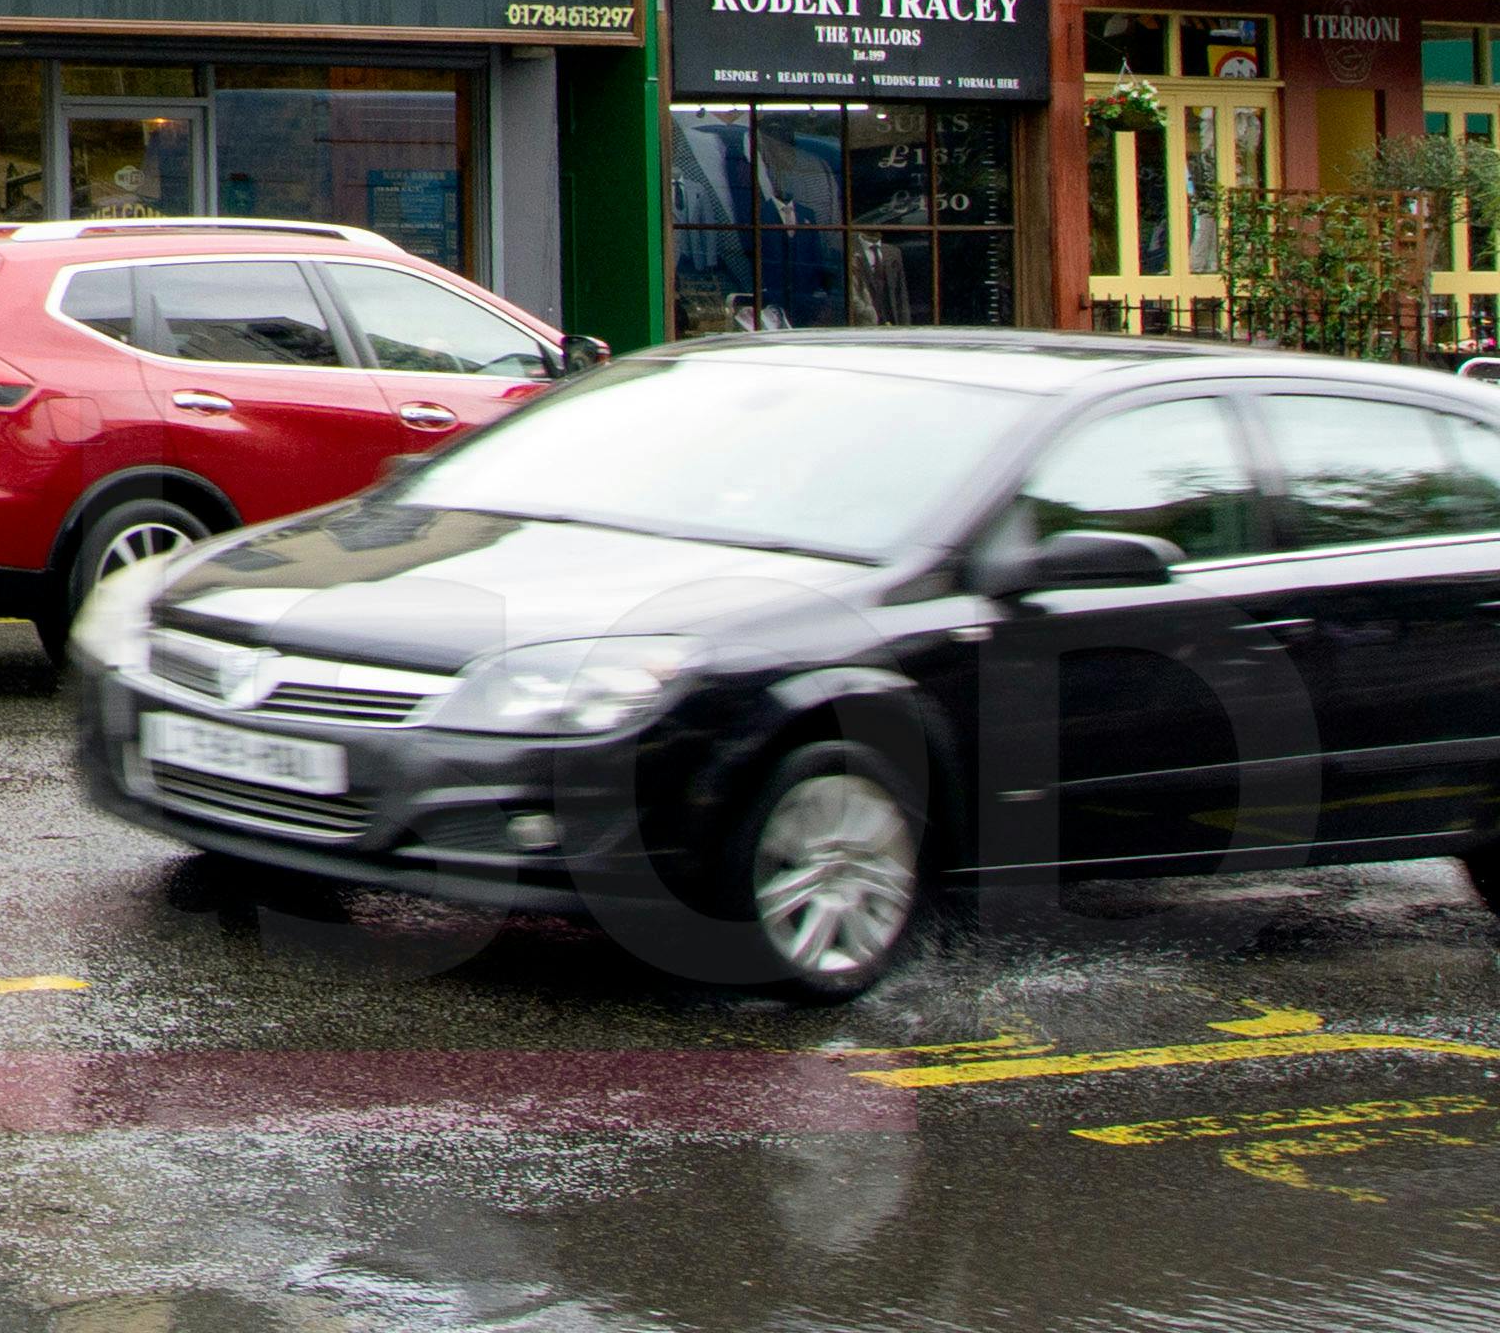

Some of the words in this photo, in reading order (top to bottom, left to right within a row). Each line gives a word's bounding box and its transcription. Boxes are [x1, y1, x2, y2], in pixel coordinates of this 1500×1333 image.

[508, 3, 634, 28] 01784613297
[815, 25, 848, 44] THE
[852, 27, 921, 46] TAILORS
[1314, 14, 1400, 42] TERRONI
[714, 69, 758, 82] BESPOKE
[778, 71, 809, 84] READY
[812, 72, 824, 84] TO
[826, 73, 854, 85] WEAR
[873, 74, 916, 87] WEDDING
[918, 76, 940, 87] HIRE
[958, 77, 995, 89] FORMAL
[997, 78, 1019, 90] HIRE
